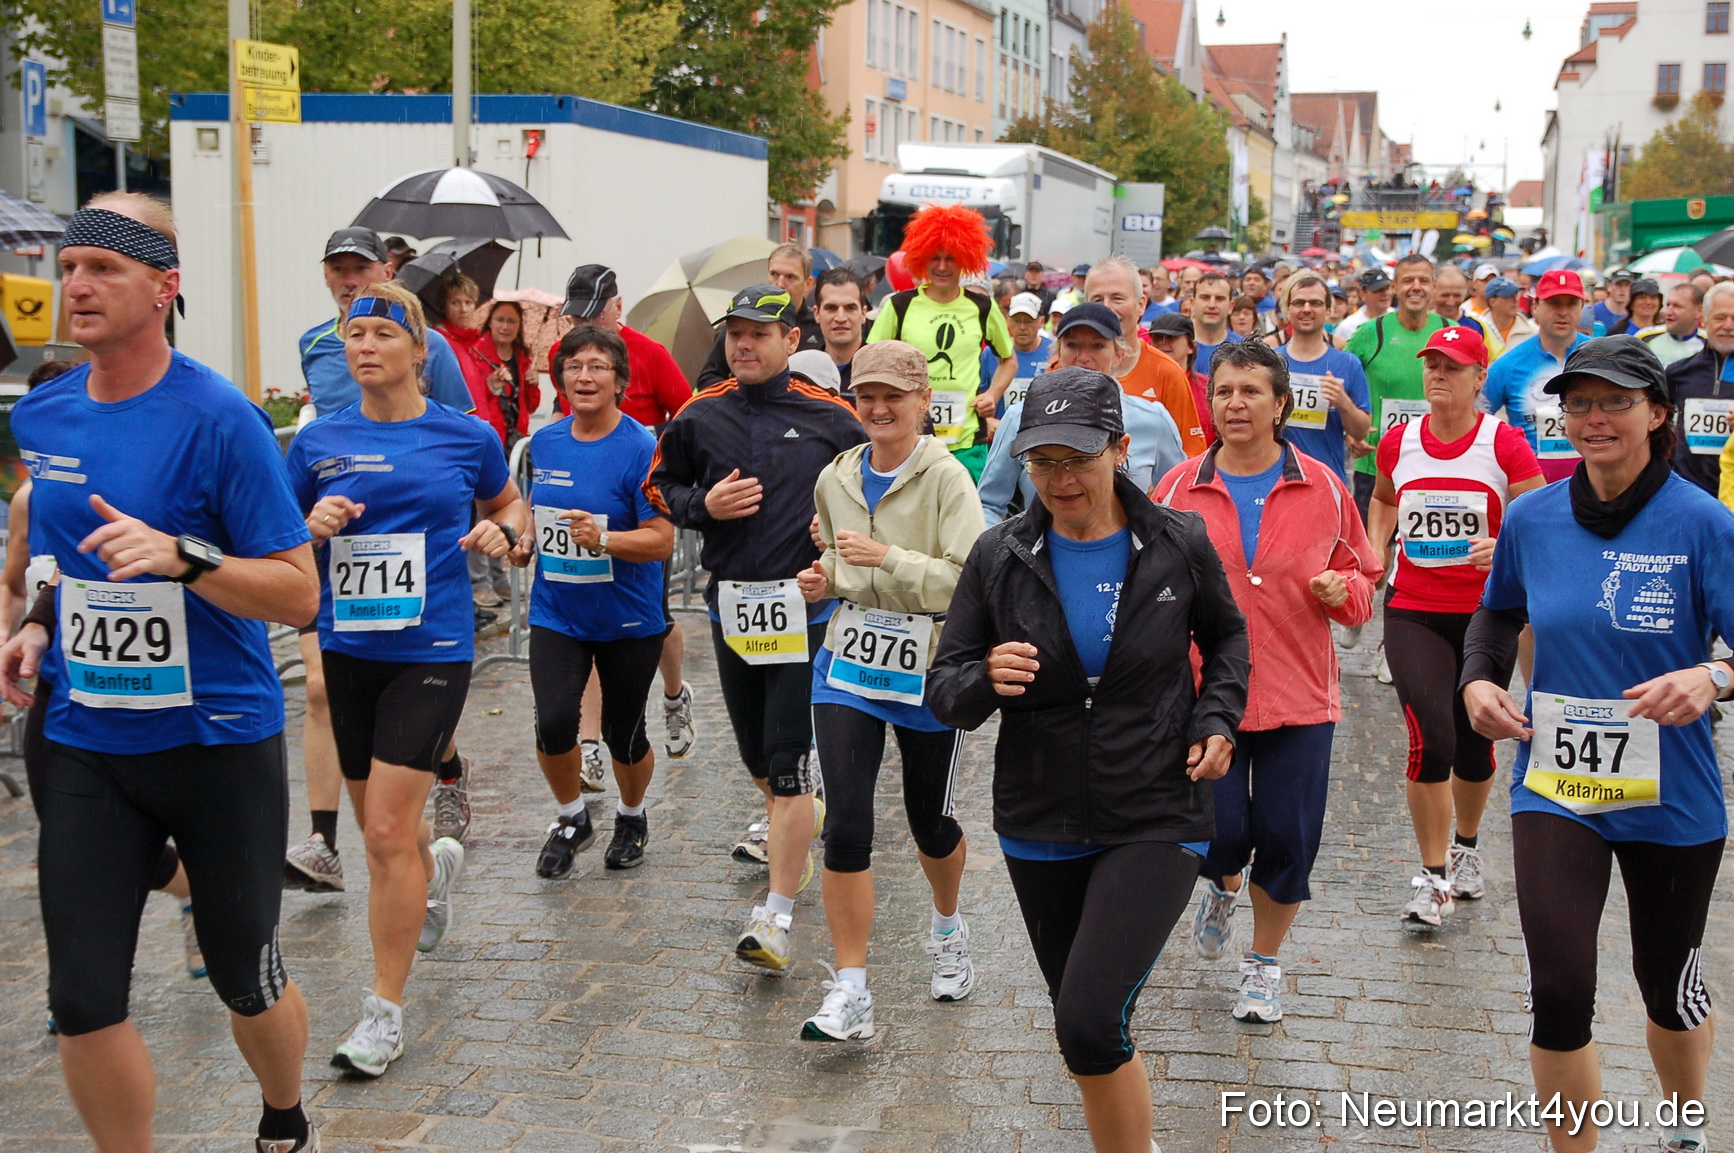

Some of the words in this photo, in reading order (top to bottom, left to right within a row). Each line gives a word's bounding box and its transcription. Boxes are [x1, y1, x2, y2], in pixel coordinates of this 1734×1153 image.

[27, 69, 41, 127] P
[910, 185, 971, 199] BOCK
[1378, 214, 1417, 226] START
[1425, 496, 1459, 504] BOCK
[1408, 511, 1480, 538] 2659
[351, 541, 391, 551] BOCK
[1420, 545, 1469, 556] Marliese
[1602, 550, 1618, 561] 12.
[1618, 552, 1688, 565] NEUMARKTER
[562, 562, 578, 573] Evi
[1613, 561, 1673, 574] STADTLAUF
[336, 560, 415, 596] 2714
[1096, 583, 1115, 593] 12.
[86, 589, 136, 604] BOCK
[350, 603, 401, 617] Annelies
[736, 601, 788, 633] 546
[864, 612, 902, 627] BOCK
[71, 612, 171, 663] 2429
[745, 639, 778, 653] Alfred
[842, 627, 918, 671] 2976
[83, 670, 153, 691] Manfred
[859, 670, 891, 688] Doris
[1563, 704, 1614, 719] BOCK
[1554, 727, 1630, 774] 547
[1555, 779, 1624, 801] Katarina
